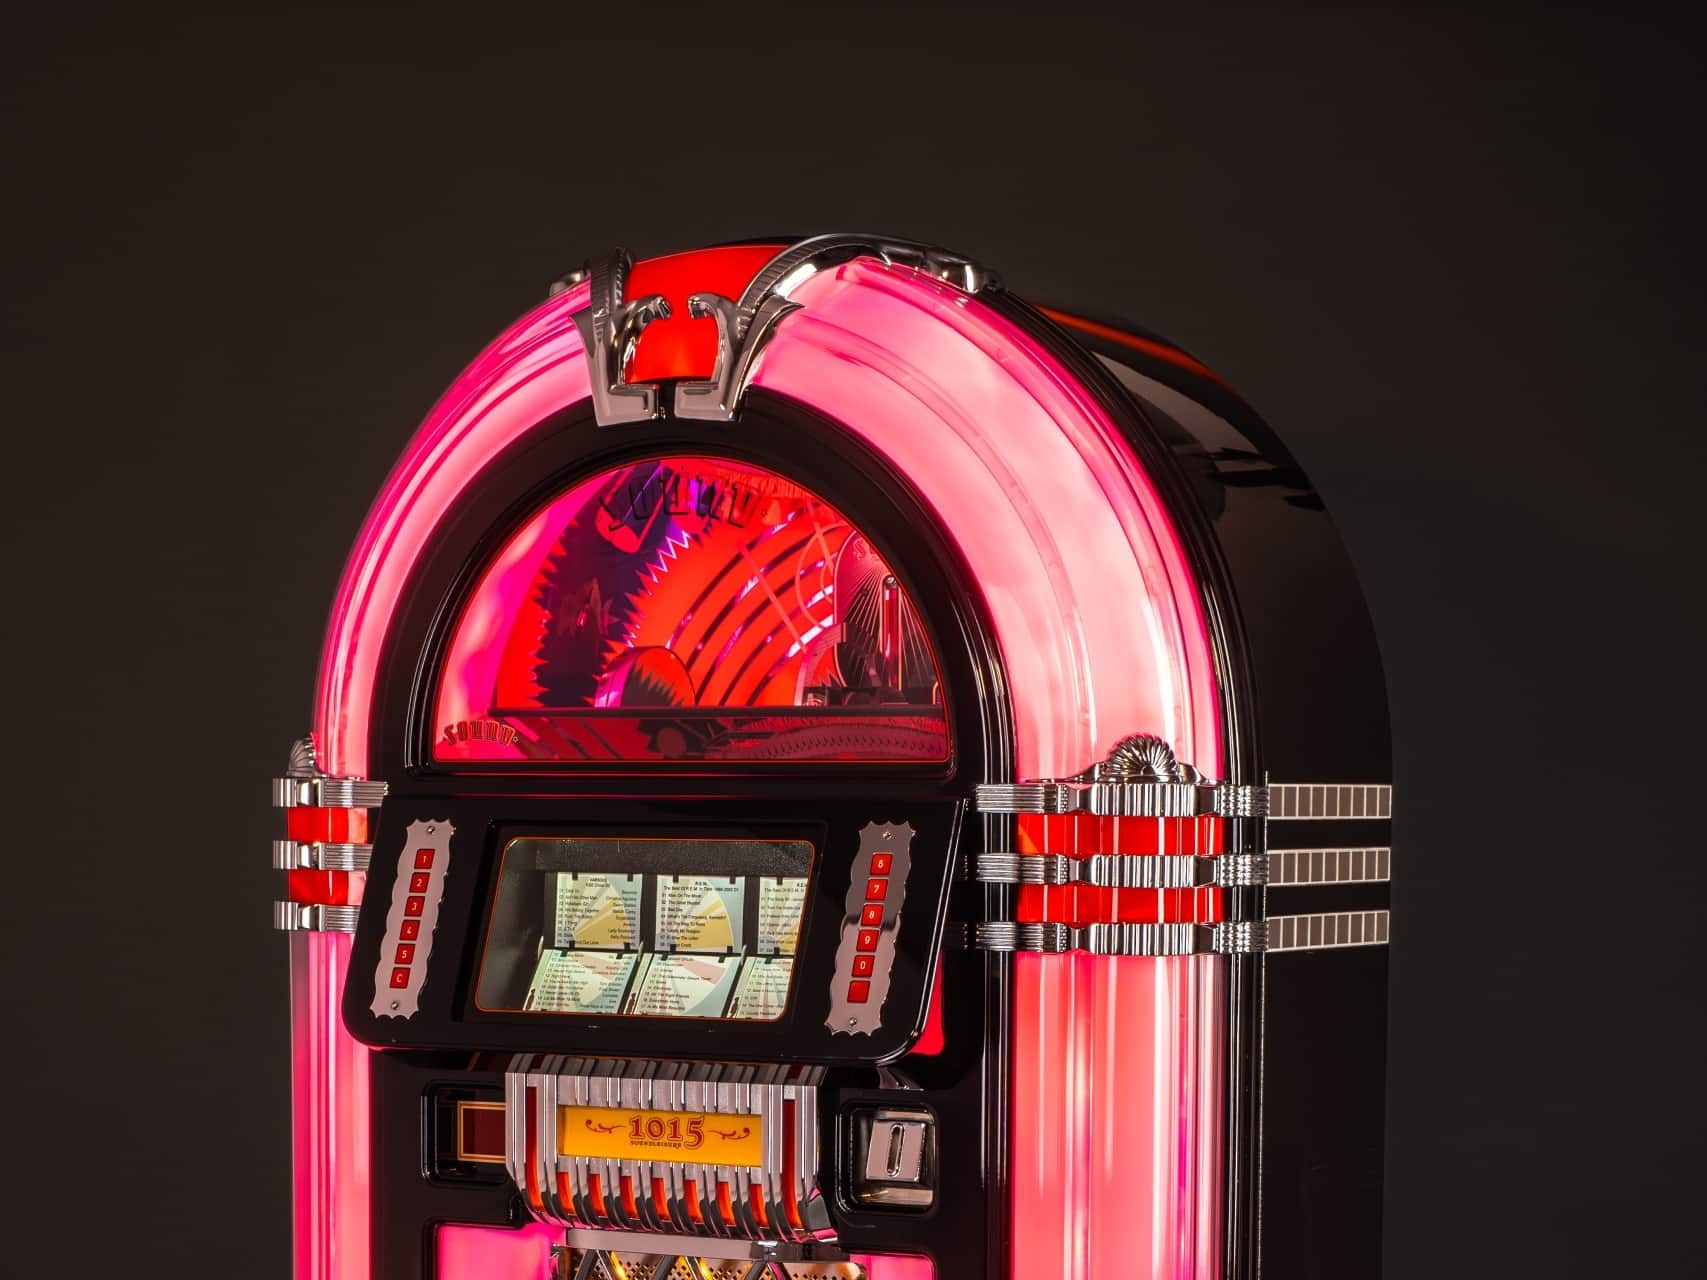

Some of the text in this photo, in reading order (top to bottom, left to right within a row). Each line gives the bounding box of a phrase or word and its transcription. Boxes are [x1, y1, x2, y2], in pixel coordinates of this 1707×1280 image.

[877, 859, 884, 868] 6
[416, 878, 423, 888] 2
[873, 884, 880, 894] 7
[411, 902, 418, 911] 3
[868, 910, 876, 919] 8
[407, 926, 413, 935] 4
[864, 935, 871, 945] 9
[401, 949, 408, 959] 5
[629, 1114, 705, 1150] 1015
